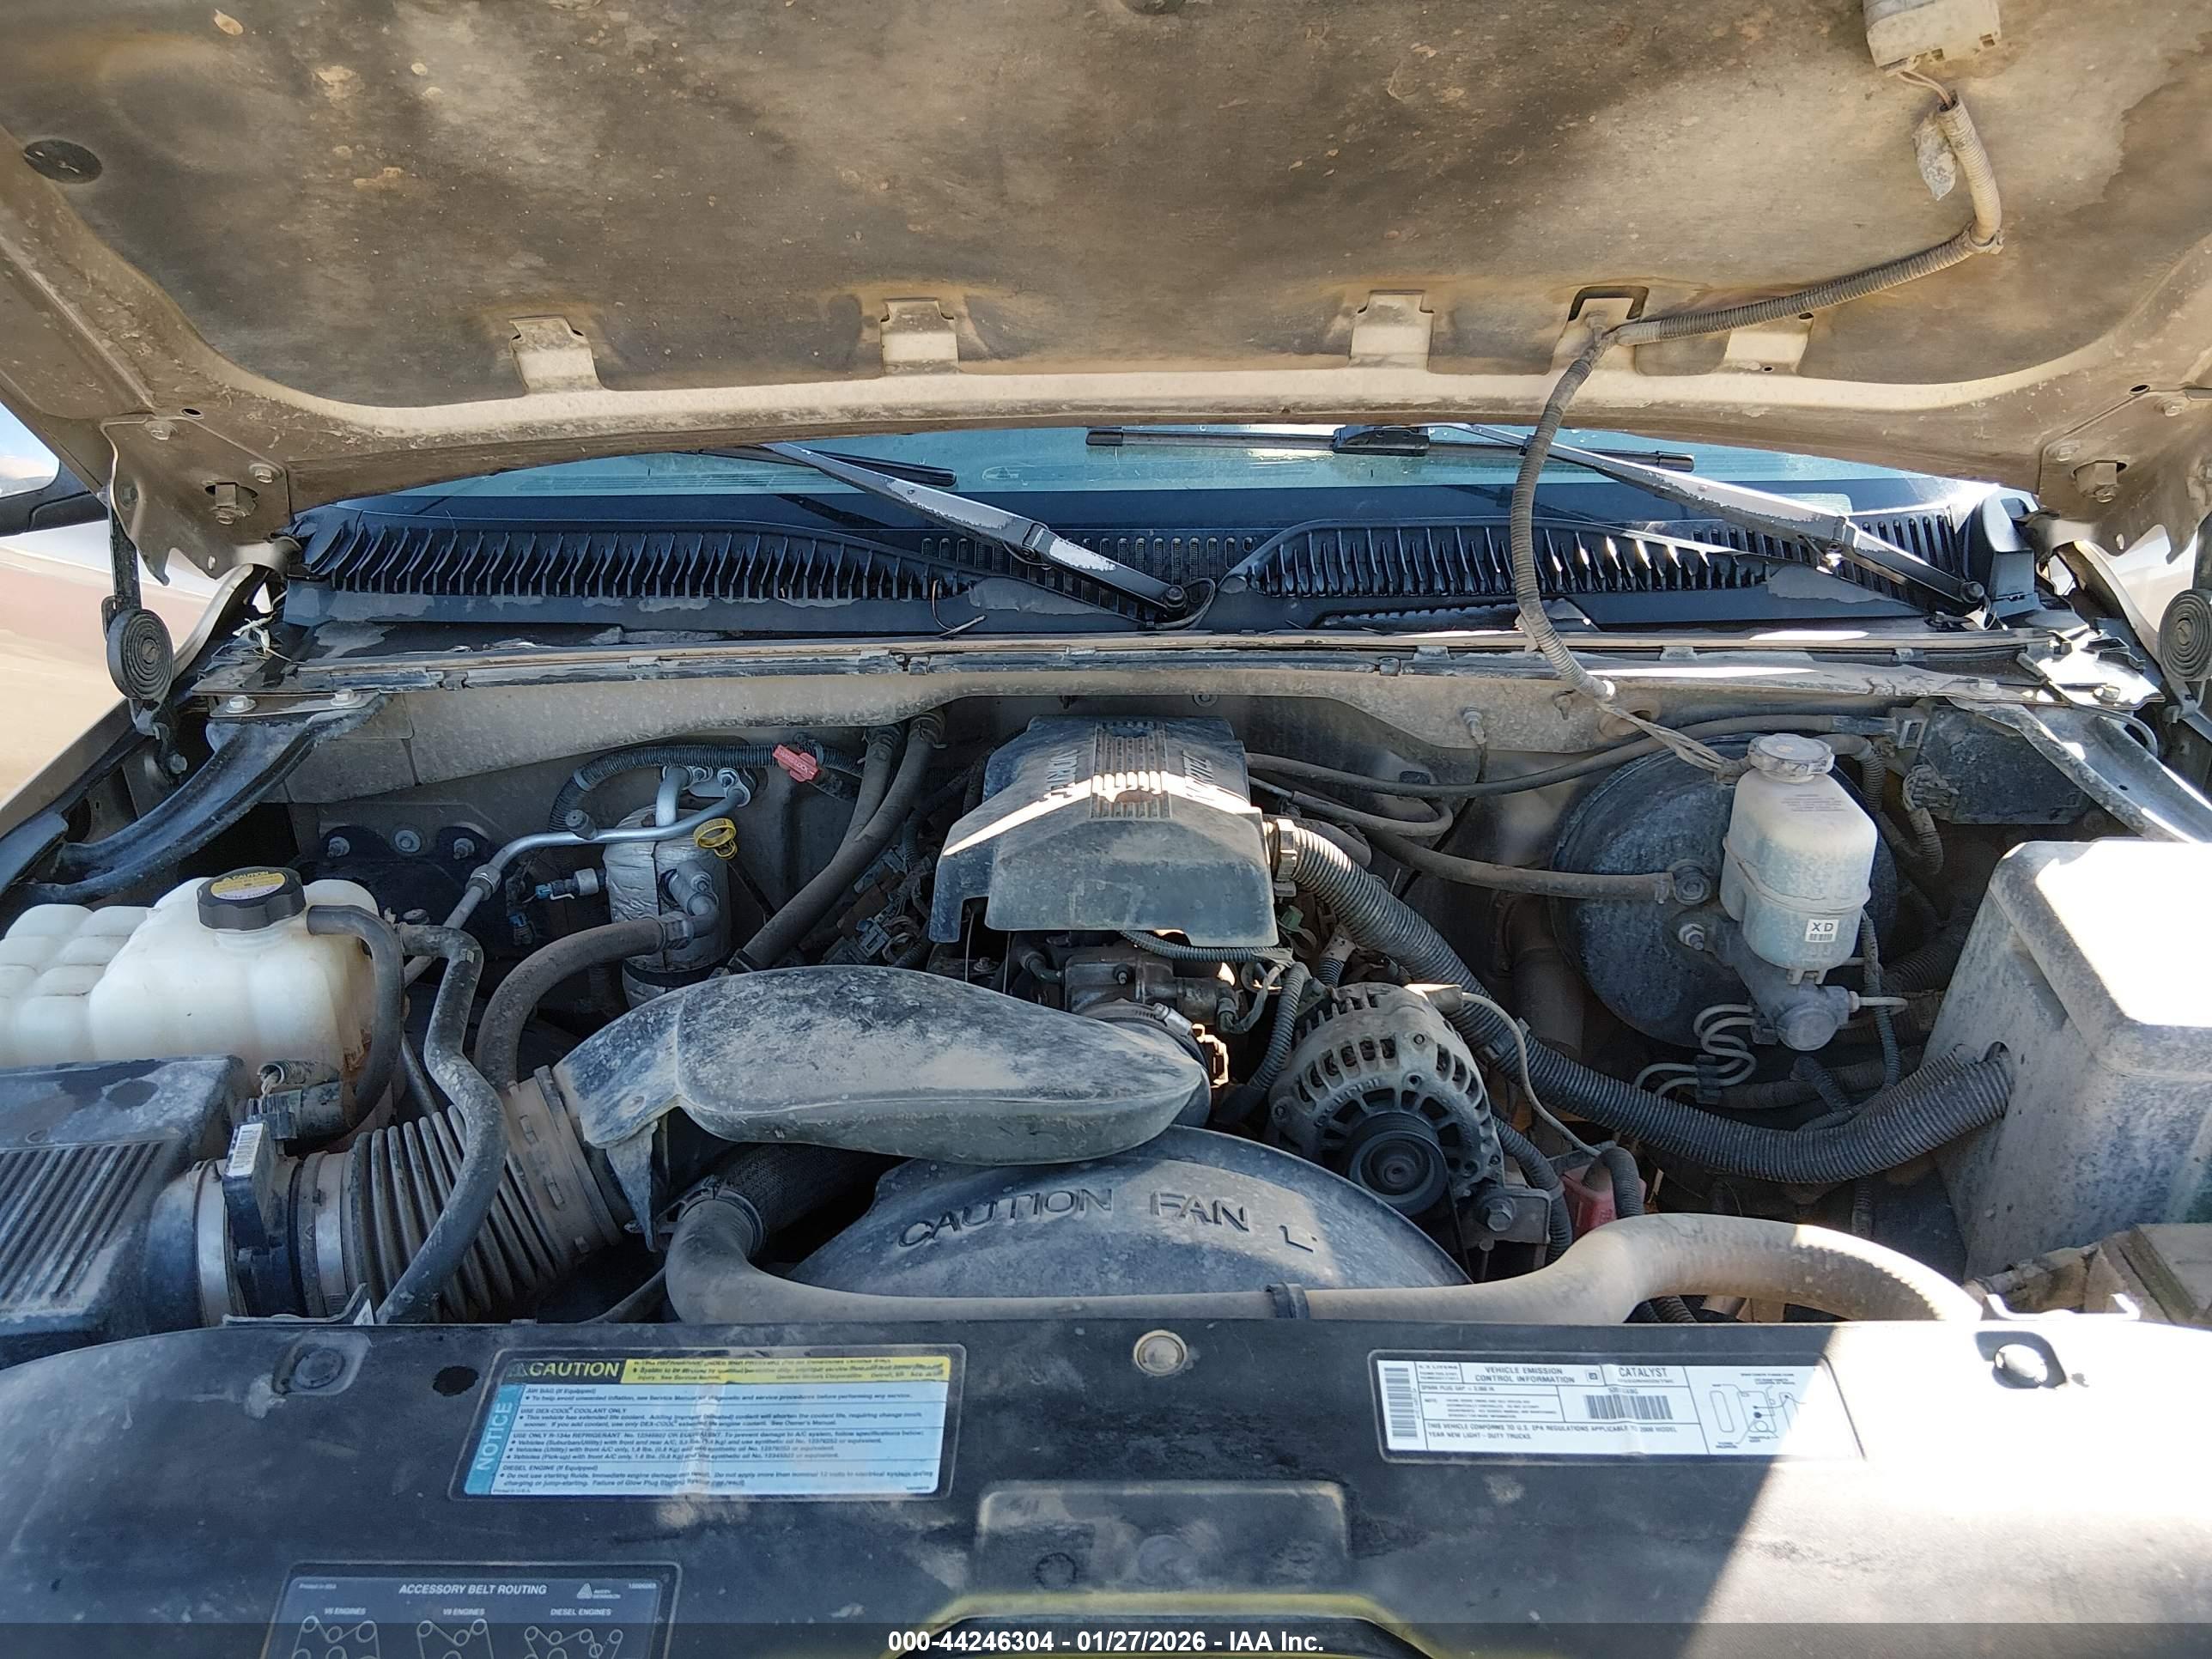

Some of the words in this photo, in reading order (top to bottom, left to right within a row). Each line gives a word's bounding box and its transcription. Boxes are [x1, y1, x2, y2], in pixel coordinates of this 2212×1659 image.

[898, 1188, 1113, 1248] CAUTION
[1152, 1190, 1250, 1232] FAN
[528, 1362, 620, 1377] CAUTION
[1619, 1367, 1668, 1377] CATALYST
[1475, 1374, 1513, 1382] CONTROL
[477, 1401, 513, 1471] NOTICE
[398, 1583, 466, 1595] ACCESSORY
[468, 1584, 495, 1595] BELT
[497, 1584, 547, 1595] ROUTING
[334, 1607, 367, 1616] ENGINES
[453, 1607, 486, 1616] ENGINES
[550, 1607, 576, 1616] DIESEL
[577, 1607, 612, 1616] ENGINES
